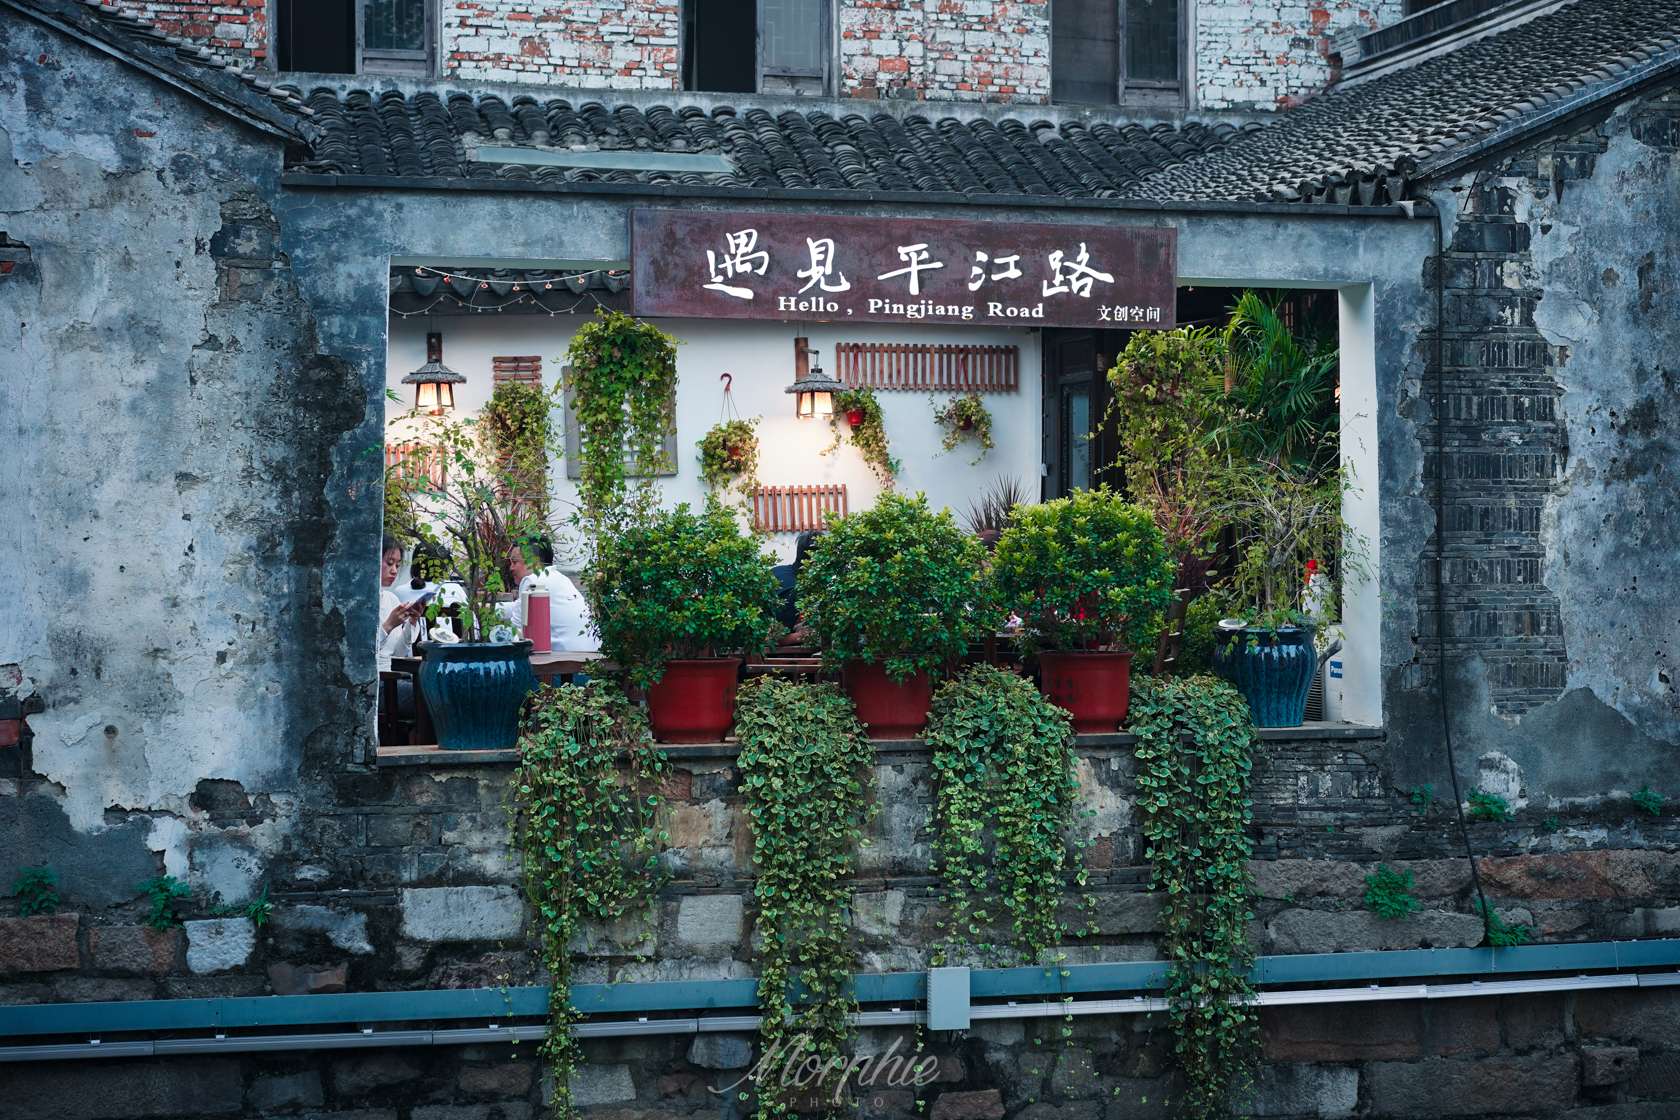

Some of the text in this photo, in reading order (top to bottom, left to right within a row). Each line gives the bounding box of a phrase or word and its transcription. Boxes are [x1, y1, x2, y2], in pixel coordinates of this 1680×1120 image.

[868, 299, 974, 320] Pingjiang
[987, 302, 1044, 318] Road
[1097, 304, 1160, 322] 文创空间
